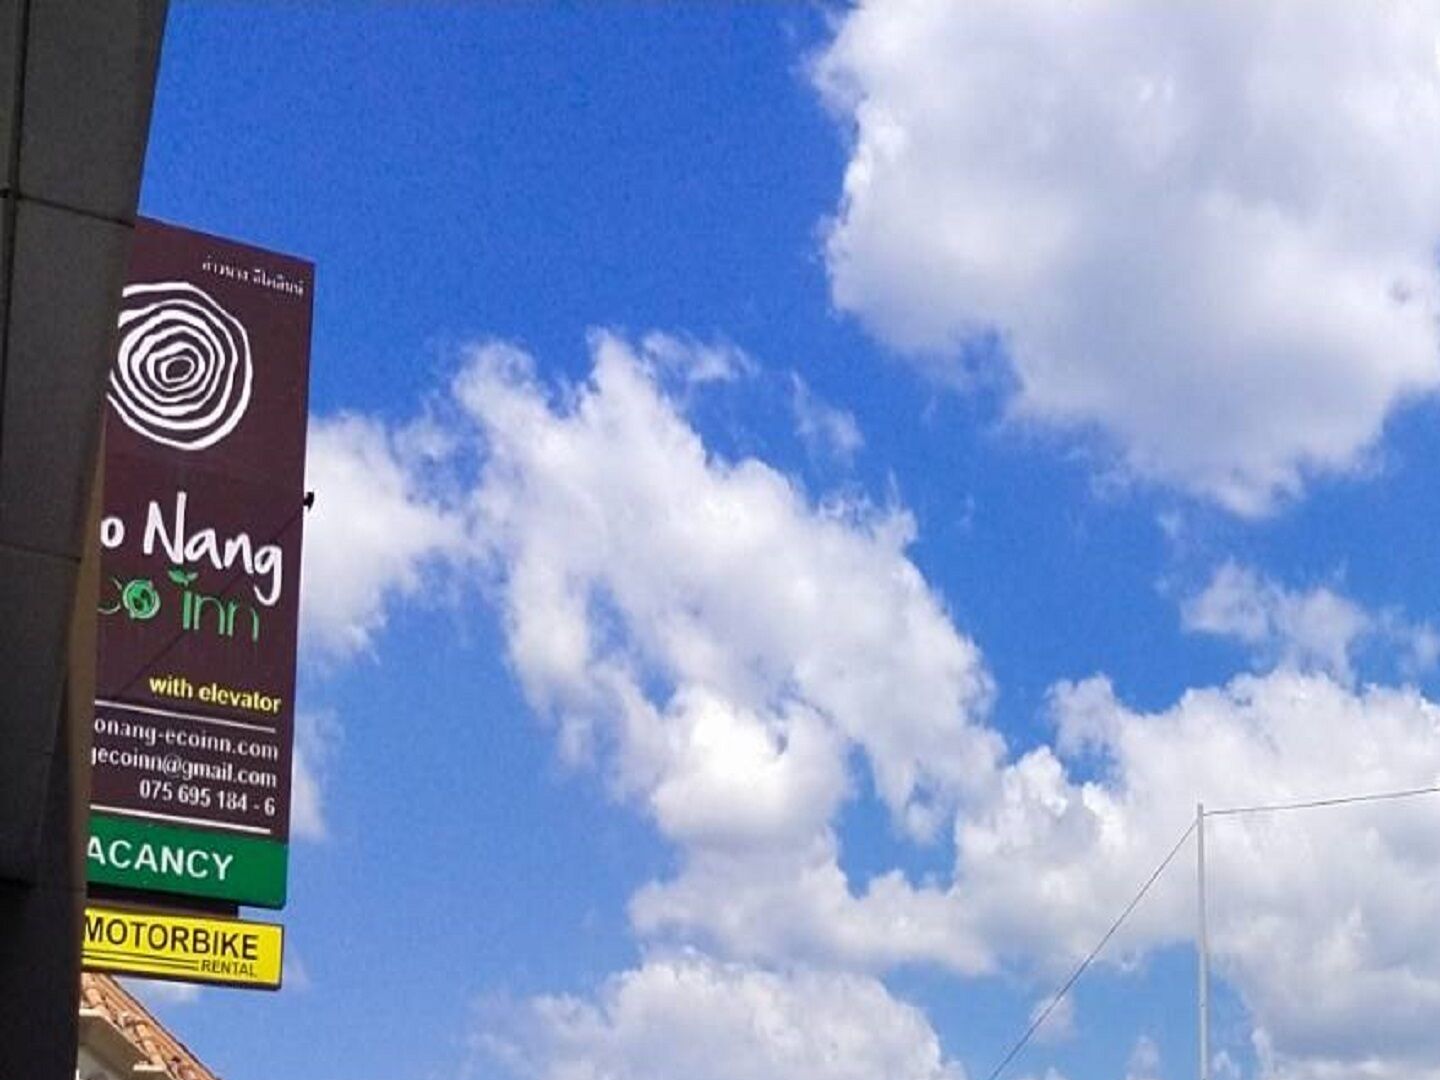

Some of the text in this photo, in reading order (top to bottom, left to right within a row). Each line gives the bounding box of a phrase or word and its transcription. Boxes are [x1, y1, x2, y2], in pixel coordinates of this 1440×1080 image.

[143, 491, 283, 606] Nang
[150, 676, 281, 714] with elevator
[139, 779, 172, 801] 075
[178, 783, 211, 807] 695
[217, 790, 248, 812] 184
[264, 796, 276, 817] 6
[84, 915, 260, 961] MOTORBIKE
[200, 959, 258, 978] RENTAL
